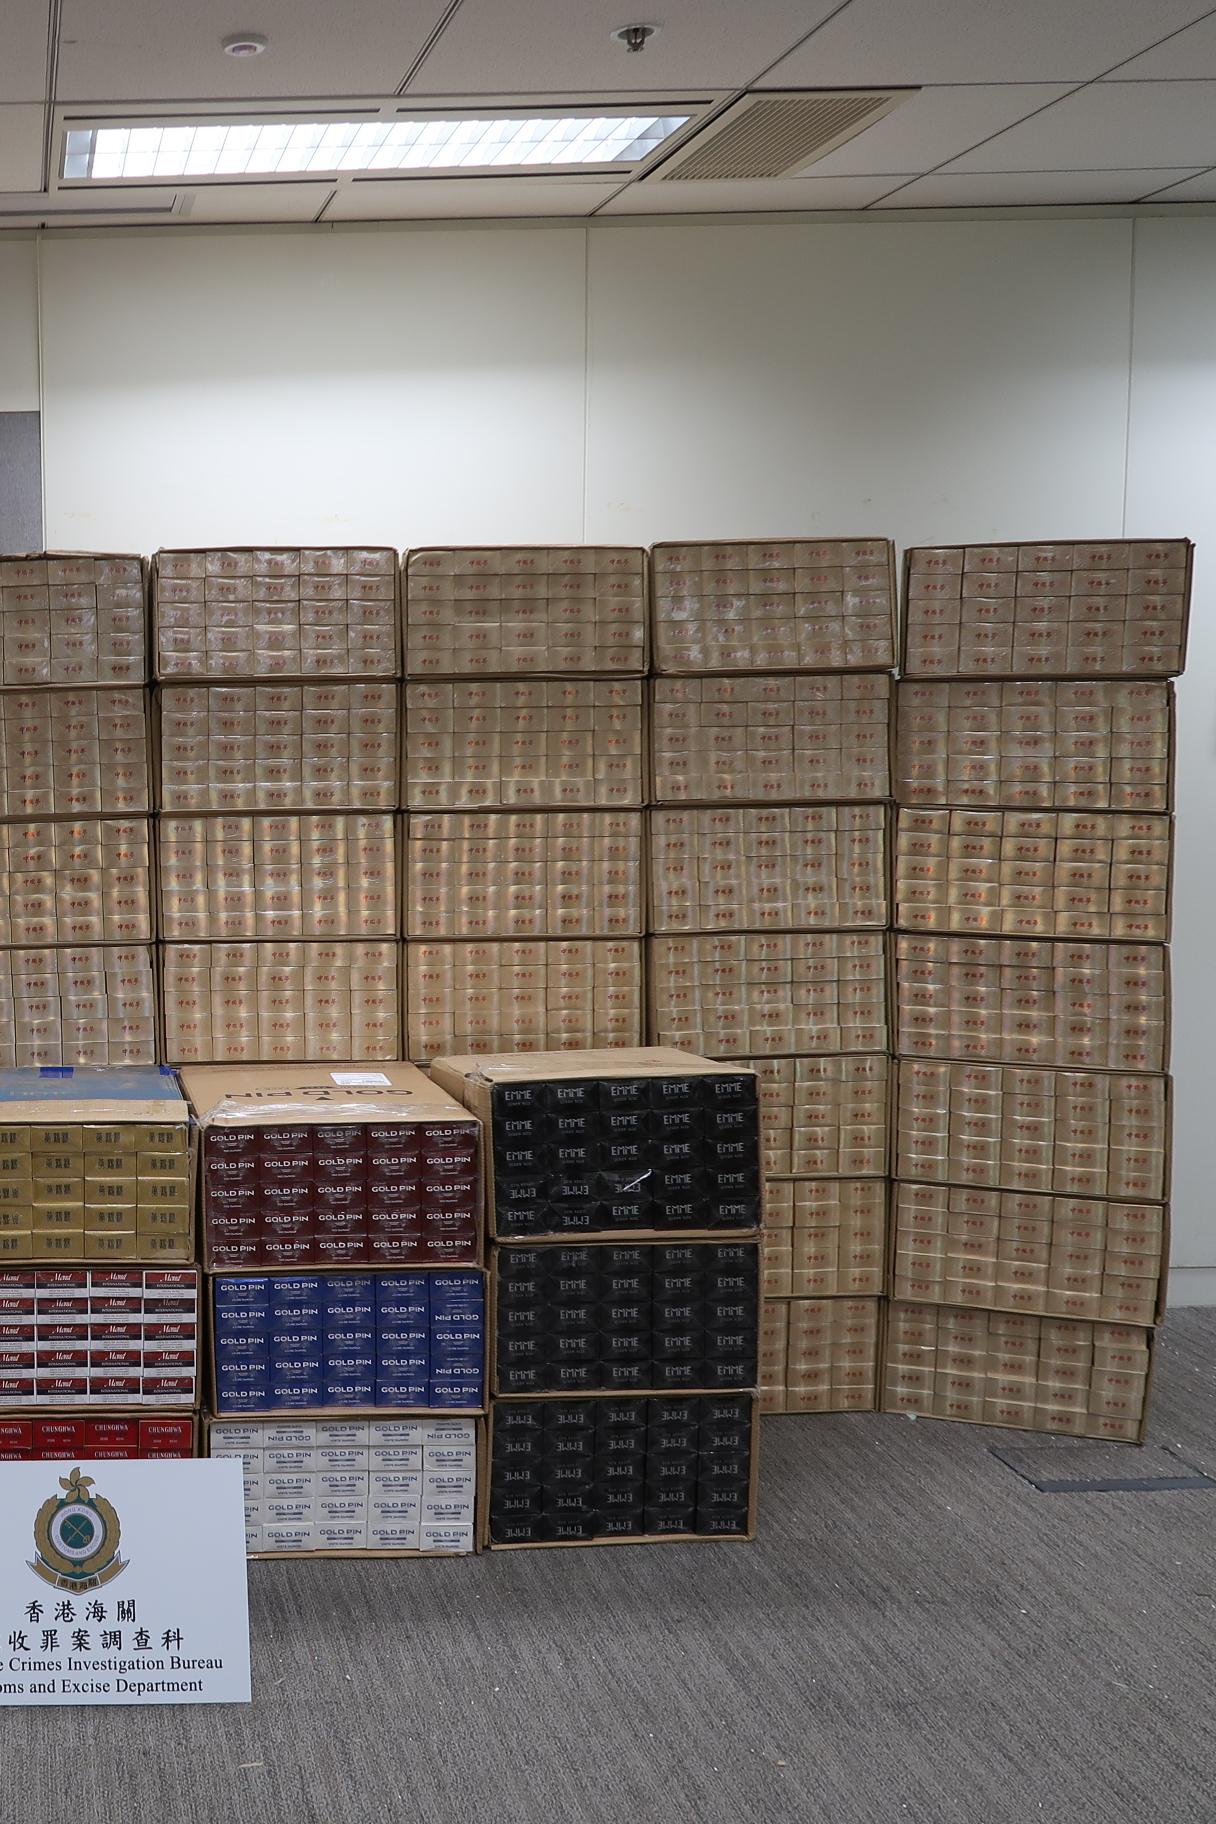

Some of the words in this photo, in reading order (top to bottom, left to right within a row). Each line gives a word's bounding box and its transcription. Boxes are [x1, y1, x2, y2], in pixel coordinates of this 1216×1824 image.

[611, 1084, 638, 1096] EMME
[663, 1082, 690, 1094] EMME
[715, 1081, 742, 1093] EMME
[224, 1091, 293, 1099] PIN
[302, 1089, 413, 1097] GOLD
[505, 1089, 532, 1101] EMME
[557, 1087, 585, 1099] EMME
[506, 1119, 533, 1131] EMME
[264, 1132, 289, 1140] GOLD
[291, 1131, 308, 1139] PIN
[317, 1131, 343, 1139] GOLD
[371, 1130, 397, 1138] GOLD
[398, 1129, 415, 1137] PIN
[426, 1129, 451, 1137] GOLD
[453, 1128, 470, 1136] PIN
[510, 1252, 537, 1264] EMME
[561, 1250, 588, 1262] EMME
[613, 1249, 641, 1261] EMME
[666, 1248, 693, 1260] EMME
[274, 1282, 299, 1290] GOLD
[381, 1279, 406, 1287] GOLD
[508, 1281, 536, 1293] EMME
[560, 1278, 587, 1290] EMME
[221, 1284, 246, 1292] GOLD
[327, 1306, 352, 1314] GOLD
[221, 1311, 246, 1319] GOLD
[42, 1425, 76, 1433] CHUNGHWA
[95, 1424, 129, 1432] CHUNGHWA
[148, 1426, 182, 1434] CHUNGHWA
[241, 1427, 258, 1435] PIN
[41, 1450, 75, 1458] CHUNGHWA
[94, 1449, 128, 1457] CHUNGHWA
[24, 1599, 136, 1623] 香港海關
[9, 1657, 61, 1671] Crimes
[67, 1656, 164, 1674] Investigation
[170, 1656, 223, 1670] Bureau
[30, 1679, 55, 1693] and
[62, 1679, 110, 1693] Excise
[116, 1679, 203, 1697] Department
